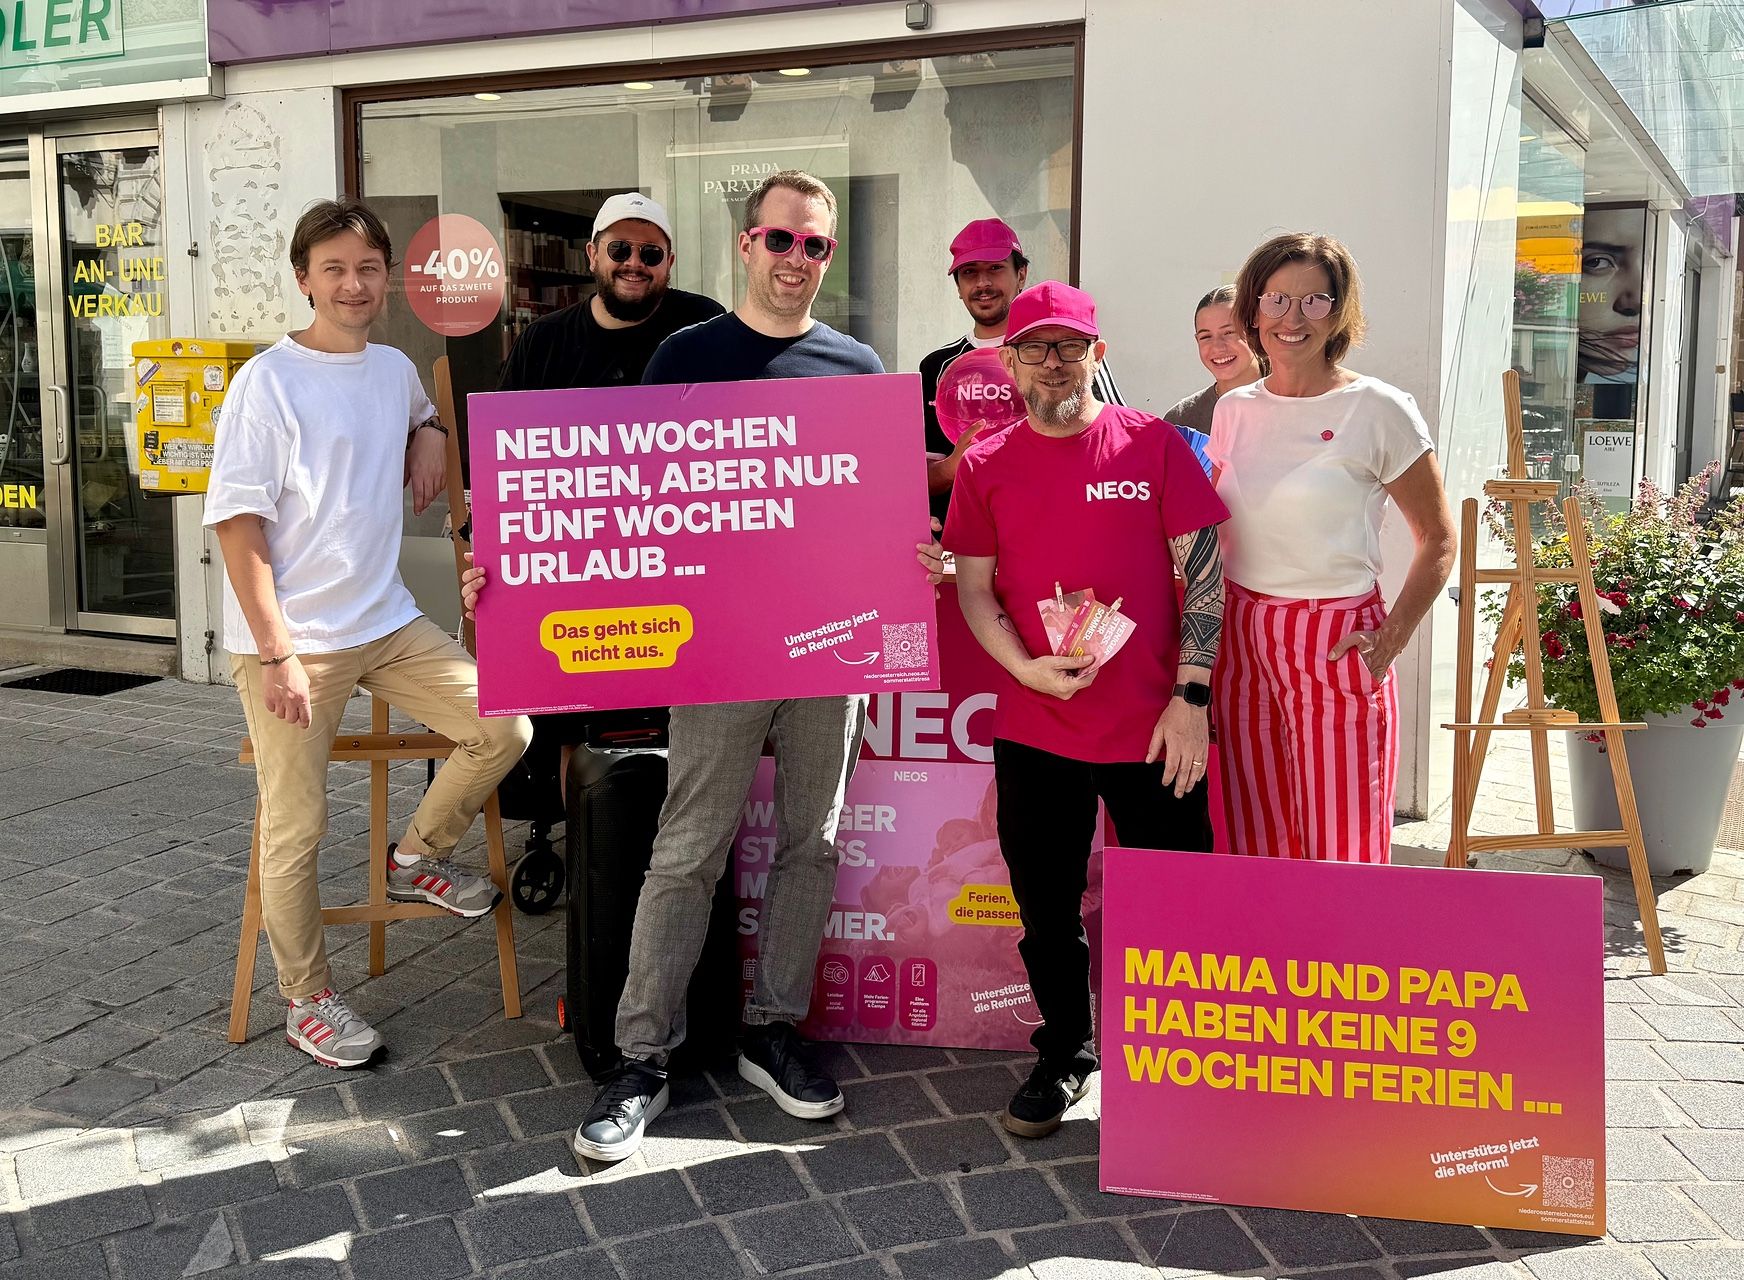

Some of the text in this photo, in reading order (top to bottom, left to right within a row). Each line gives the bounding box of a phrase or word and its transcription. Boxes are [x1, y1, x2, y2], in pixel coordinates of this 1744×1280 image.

[0, 0, 112, 52] LER
[731, 162, 781, 175] PRADA
[95, 222, 144, 248] BAR
[73, 259, 114, 283] AN-
[410, 247, 500, 280] -40%
[420, 282, 493, 293] AUF DAS ZWEITE
[436, 295, 479, 304] PRODUKT
[957, 383, 1012, 401] NEOS
[496, 415, 797, 461] NEUN WOCHEN
[1589, 435, 1632, 447] LOEWE
[497, 453, 860, 503] FERIEN, ABER NUR
[0, 484, 36, 509] EN
[1085, 480, 1151, 502] NEOS
[499, 497, 795, 544] FÜNF WOCHEN
[500, 546, 667, 586] URLAUB
[553, 617, 681, 641] Das geht sich
[784, 608, 880, 646] Unterstütze jetzt
[572, 644, 664, 662] nicht aus.
[788, 630, 854, 659] die Reform!
[893, 770, 928, 782] NEOS
[968, 891, 1010, 906] Ferien,
[955, 906, 1019, 920] die passen
[1125, 947, 1529, 1012] MAMA UND PAPA
[970, 983, 1031, 1002] Unterstütze
[974, 992, 1031, 1013] die Reform!
[1124, 995, 1477, 1058] HABEN KEINE 9
[1122, 1044, 1333, 1097] WOCHEN
[1343, 1061, 1513, 1111] FERIEN
[1430, 1136, 1540, 1165] Unterstütze jetzt
[1434, 1155, 1510, 1179] die Reform!
[1518, 1208, 1594, 1220] niederoesterreich.neos.eu/
[1540, 1216, 1595, 1226] sommerstattstress
